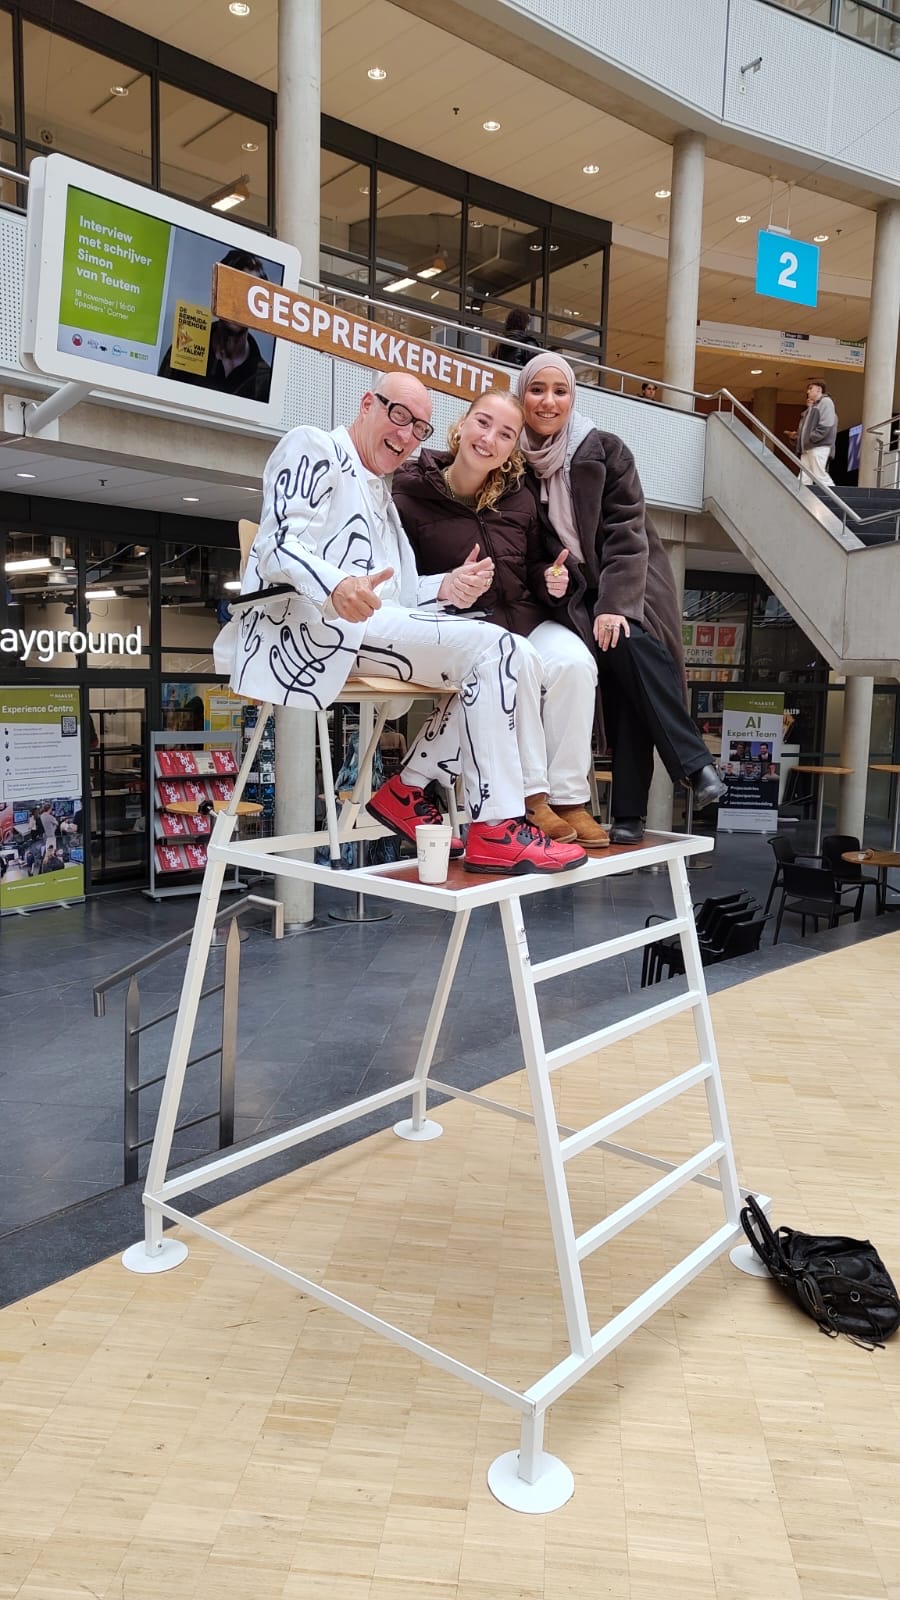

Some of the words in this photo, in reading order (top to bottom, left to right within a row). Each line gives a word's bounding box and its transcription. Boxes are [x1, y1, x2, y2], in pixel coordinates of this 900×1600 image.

[79, 215, 133, 243] Interview
[77, 248, 113, 270] Simon
[78, 234, 102, 249] met
[103, 243, 152, 267] schrijver
[778, 251, 798, 289] 2
[76, 267, 98, 281] van
[100, 271, 141, 294] Teutem
[75, 288, 82, 297] 18
[83, 292, 115, 306] november
[106, 307, 129, 320] Corner
[193, 343, 206, 352] VAN
[247, 284, 494, 393] GESPREKKERETTE
[183, 346, 205, 358] TALENT
[0, 625, 142, 662] ayground
[701, 649, 713, 657] THE
[1, 704, 46, 715] Experience
[47, 704, 74, 713] Centre
[745, 716, 762, 729] AI
[727, 729, 754, 738] Expert
[755, 730, 777, 738] Team
